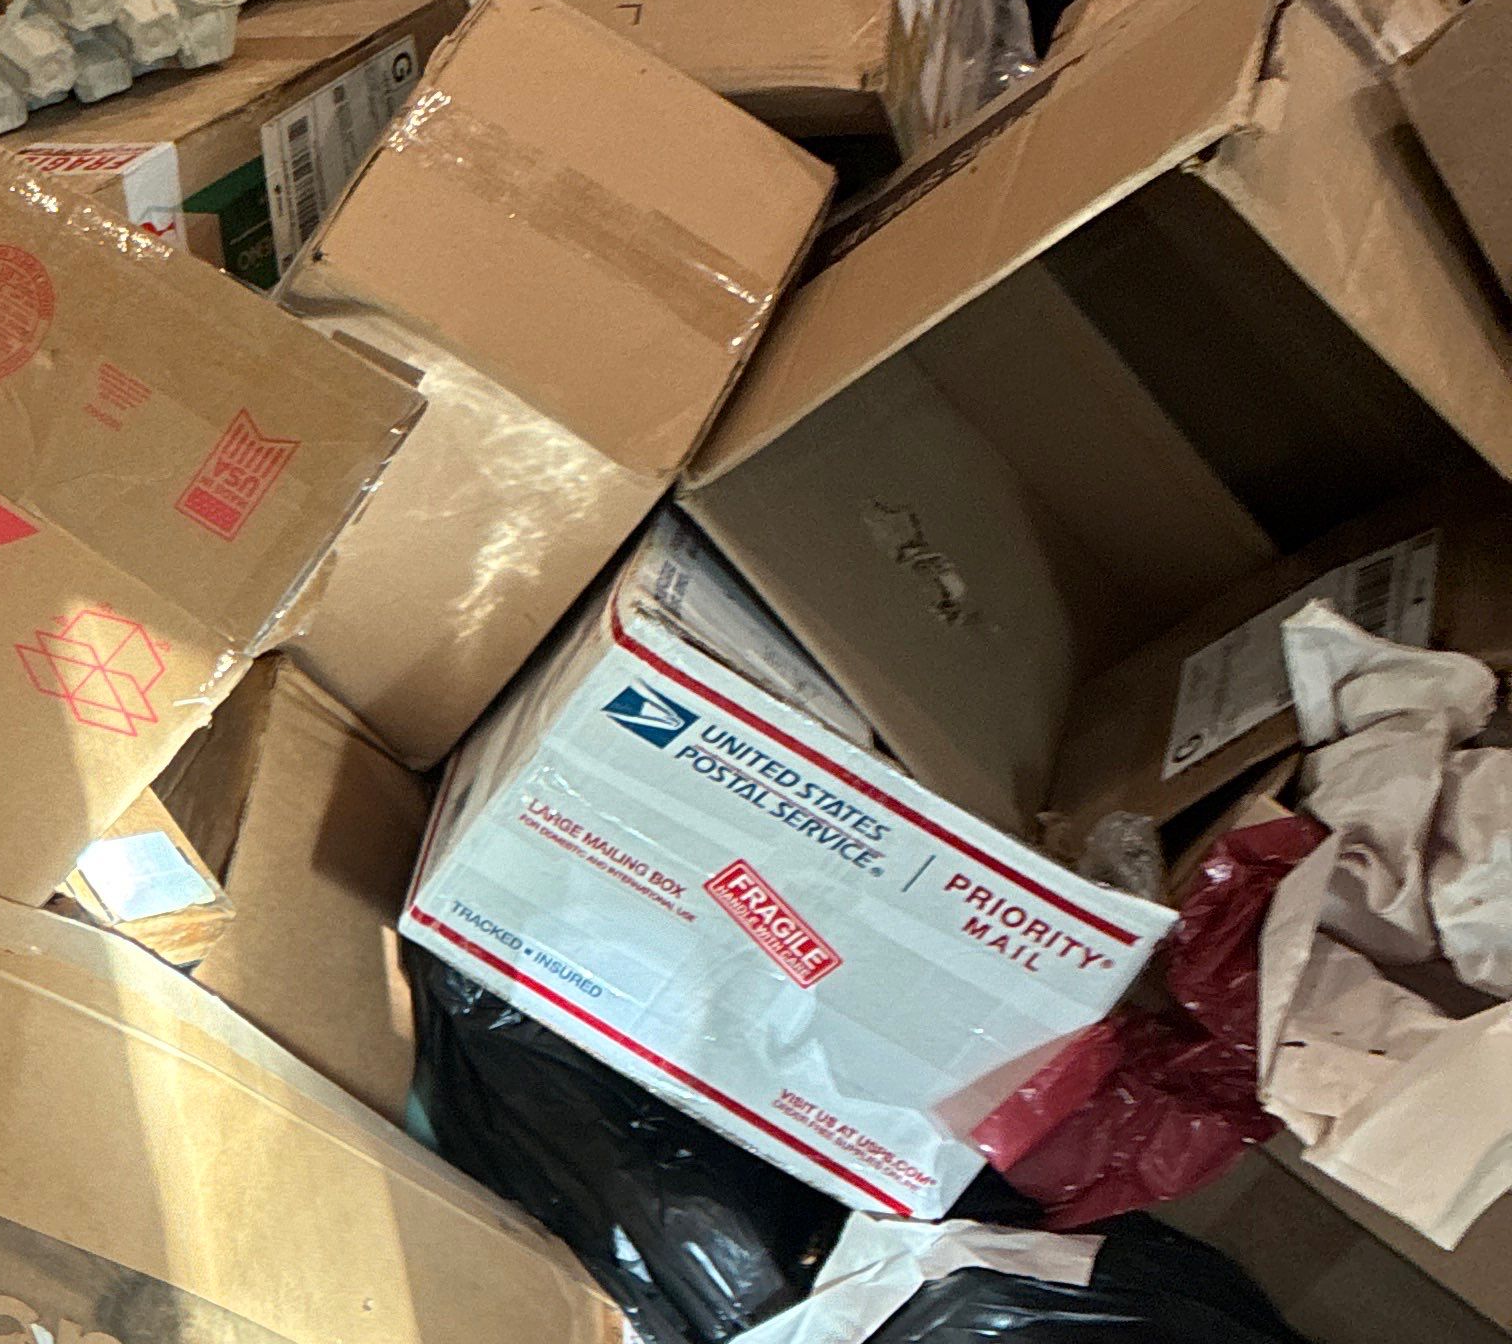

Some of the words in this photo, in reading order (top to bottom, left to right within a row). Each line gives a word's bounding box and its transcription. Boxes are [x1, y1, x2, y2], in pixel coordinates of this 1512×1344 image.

[674, 746, 772, 809] POSTAL
[701, 724, 801, 788] UNITED
[794, 782, 892, 842] STATES
[527, 798, 585, 838] LARGE
[581, 832, 650, 877] MAILING
[647, 871, 688, 900] BOX
[451, 899, 524, 951] TRACKED
[533, 950, 604, 998] INSURED
[728, 873, 830, 971] FRAGILE
[944, 873, 1105, 970] PRIORITY
[961, 916, 1041, 972] MAIL
[780, 1088, 817, 1114] VISIT
[814, 1109, 838, 1128] US
[836, 1125, 859, 1139] AT
